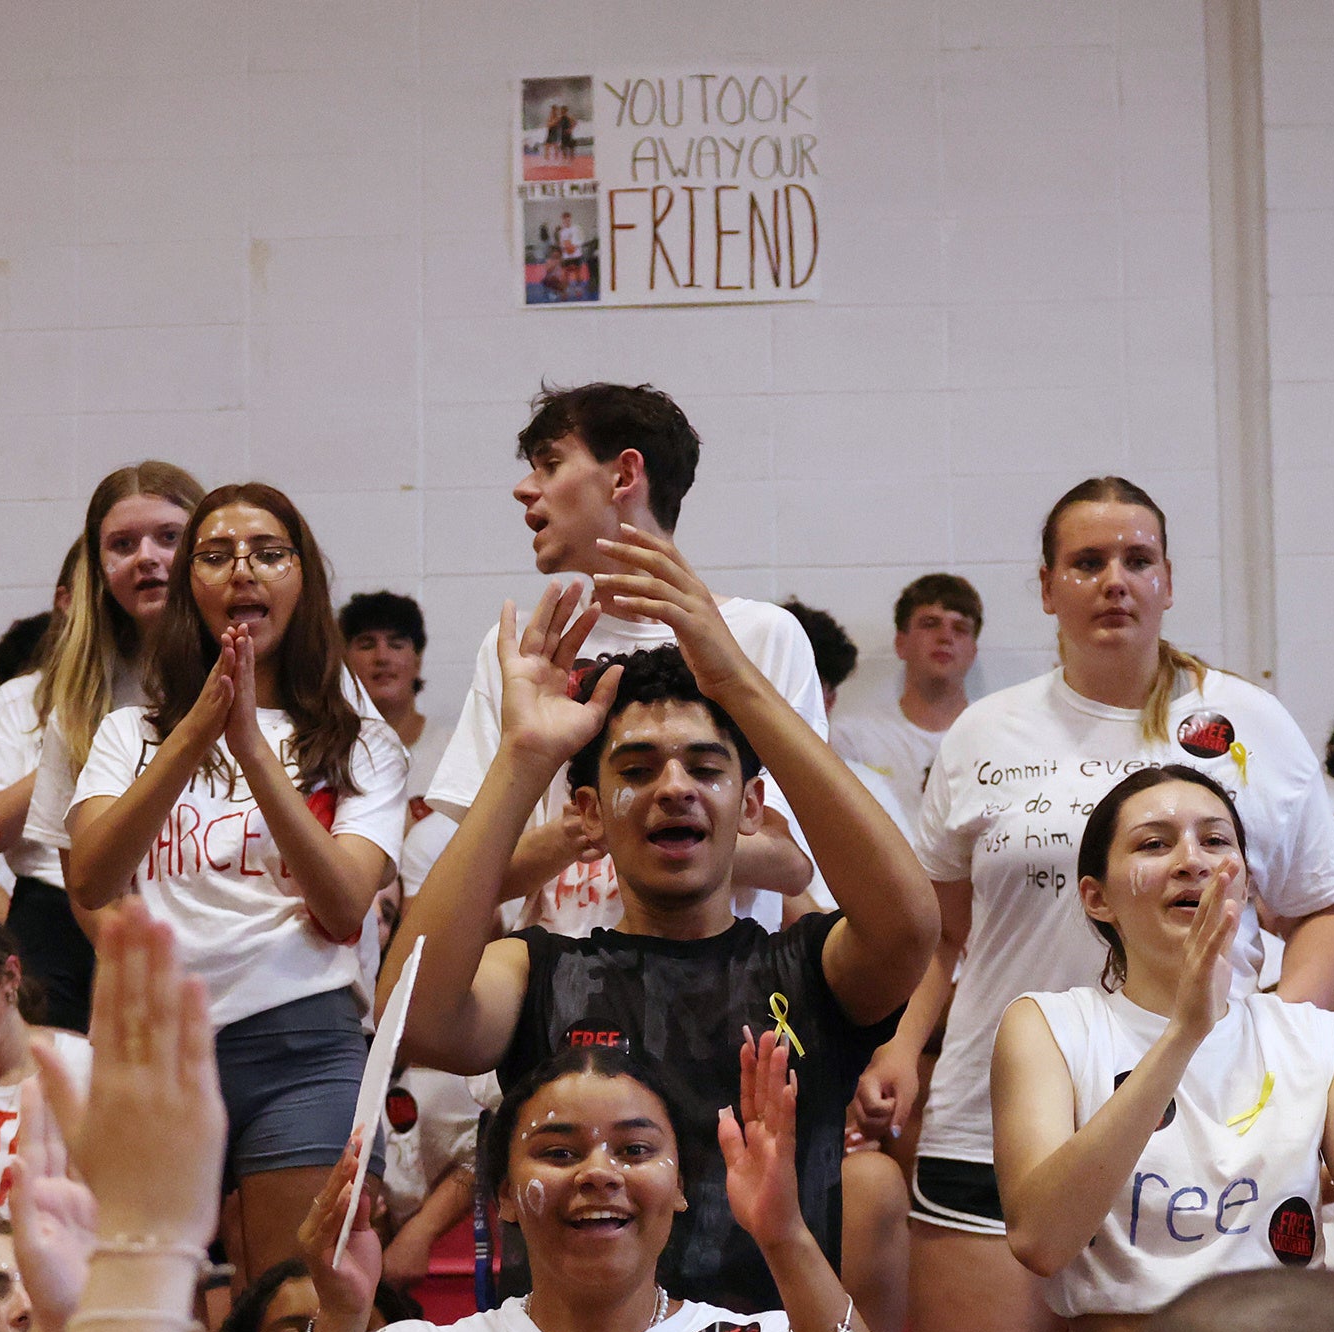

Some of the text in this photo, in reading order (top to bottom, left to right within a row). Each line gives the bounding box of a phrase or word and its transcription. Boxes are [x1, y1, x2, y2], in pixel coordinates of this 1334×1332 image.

[604, 74, 813, 127] YOU TOOK
[632, 134, 819, 181] AWAY OUR
[609, 184, 819, 291] FRIEND
[1025, 792, 1052, 814] do
[1025, 863, 1066, 898] Help
[1129, 1171, 1259, 1246] ree
[1279, 1210, 1312, 1238] FREE
